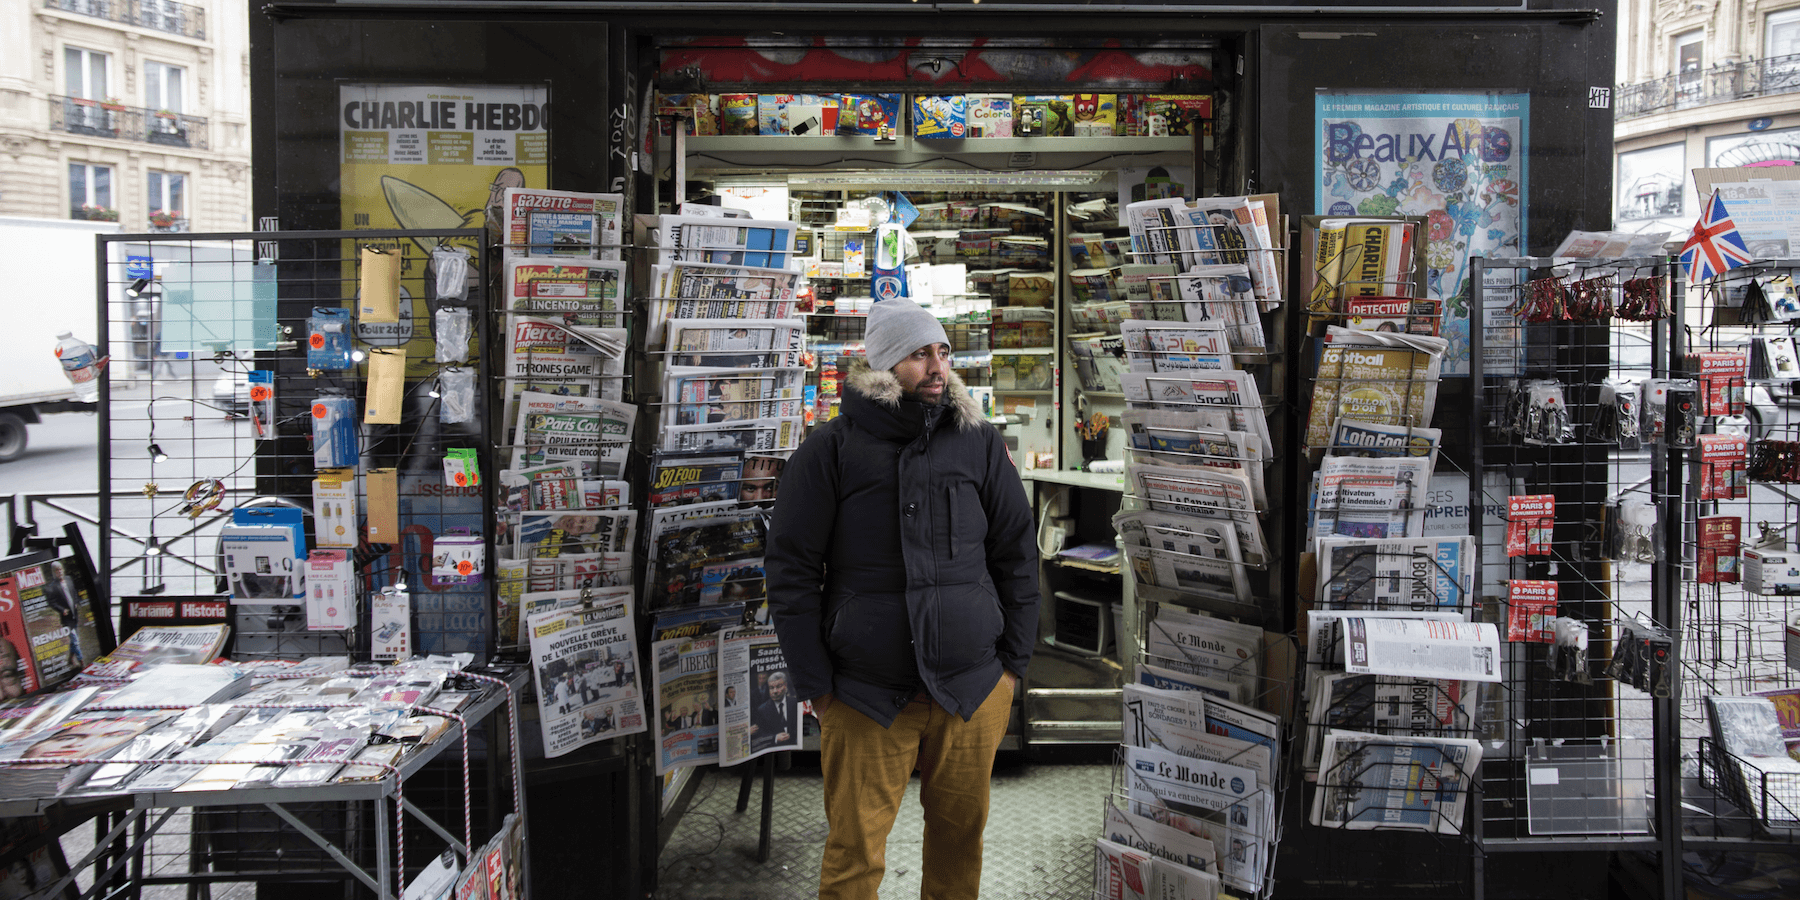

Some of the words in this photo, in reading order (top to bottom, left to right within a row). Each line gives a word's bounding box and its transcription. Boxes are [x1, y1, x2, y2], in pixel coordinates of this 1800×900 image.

[774, 94, 795, 104] JEUX
[974, 109, 1011, 118] Coloria
[1484, 103, 1519, 112] FRANÇAIS
[344, 101, 456, 129] CHARLIE
[354, 214, 370, 226] UN
[1352, 303, 1408, 314] DETECTIVE
[359, 324, 385, 334] Pour
[792, 328, 800, 337] El
[1322, 350, 1384, 366] football
[516, 364, 562, 374] THRONES
[564, 365, 591, 374] GAME
[1344, 397, 1386, 406] BALLON
[544, 417, 575, 430] Paris
[576, 419, 626, 433] Courses
[655, 470, 675, 489] SO
[674, 468, 702, 480] FOOT
[1706, 523, 1732, 532] Paris
[1412, 546, 1427, 558] LA
[1437, 548, 1452, 558] Le
[1411, 562, 1427, 599] BONNE
[130, 603, 174, 618] Marianne
[182, 603, 226, 618] Historia
[583, 613, 592, 622] Le
[592, 608, 625, 620] Quotidien
[32, 627, 70, 647] RENAUD
[550, 633, 588, 651] NOUVELLE
[591, 627, 617, 639] GRÈVE
[724, 629, 735, 640] El
[556, 633, 627, 658] L'INTERSYNDICALE
[694, 640, 716, 649] 2004
[1177, 632, 1186, 645] Le
[1189, 635, 1226, 652] Monde
[751, 656, 779, 667] poussé
[1148, 712, 1181, 724] SONDAGES
[1157, 761, 1171, 777] Le
[1175, 764, 1226, 789] Monde
[1154, 787, 1166, 796] qui
[1178, 791, 1208, 805] entuber
[1210, 798, 1222, 808] qui
[1127, 835, 1150, 852] Les
[1150, 843, 1183, 864] Echos
